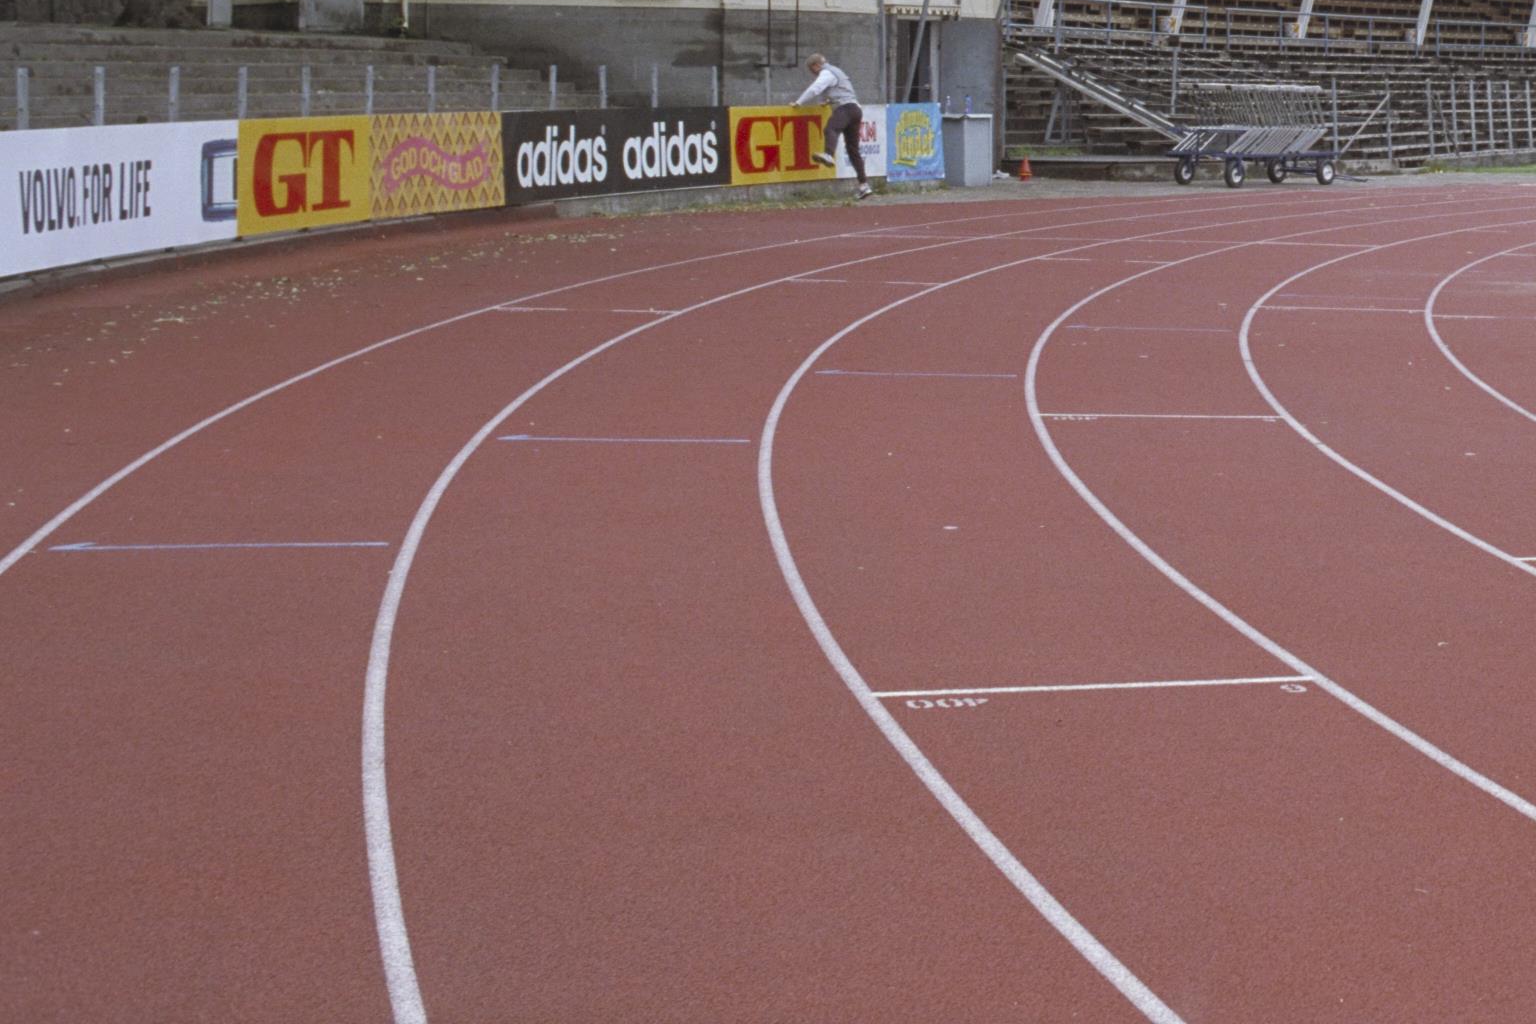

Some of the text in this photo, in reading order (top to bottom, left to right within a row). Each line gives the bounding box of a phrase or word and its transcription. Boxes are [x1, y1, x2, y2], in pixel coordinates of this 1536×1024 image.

[253, 129, 355, 217] GT
[448, 156, 482, 183] GLAD
[517, 125, 608, 188] adidas
[623, 121, 718, 180] adidas
[736, 115, 821, 174] GT
[119, 160, 152, 220] LIFE
